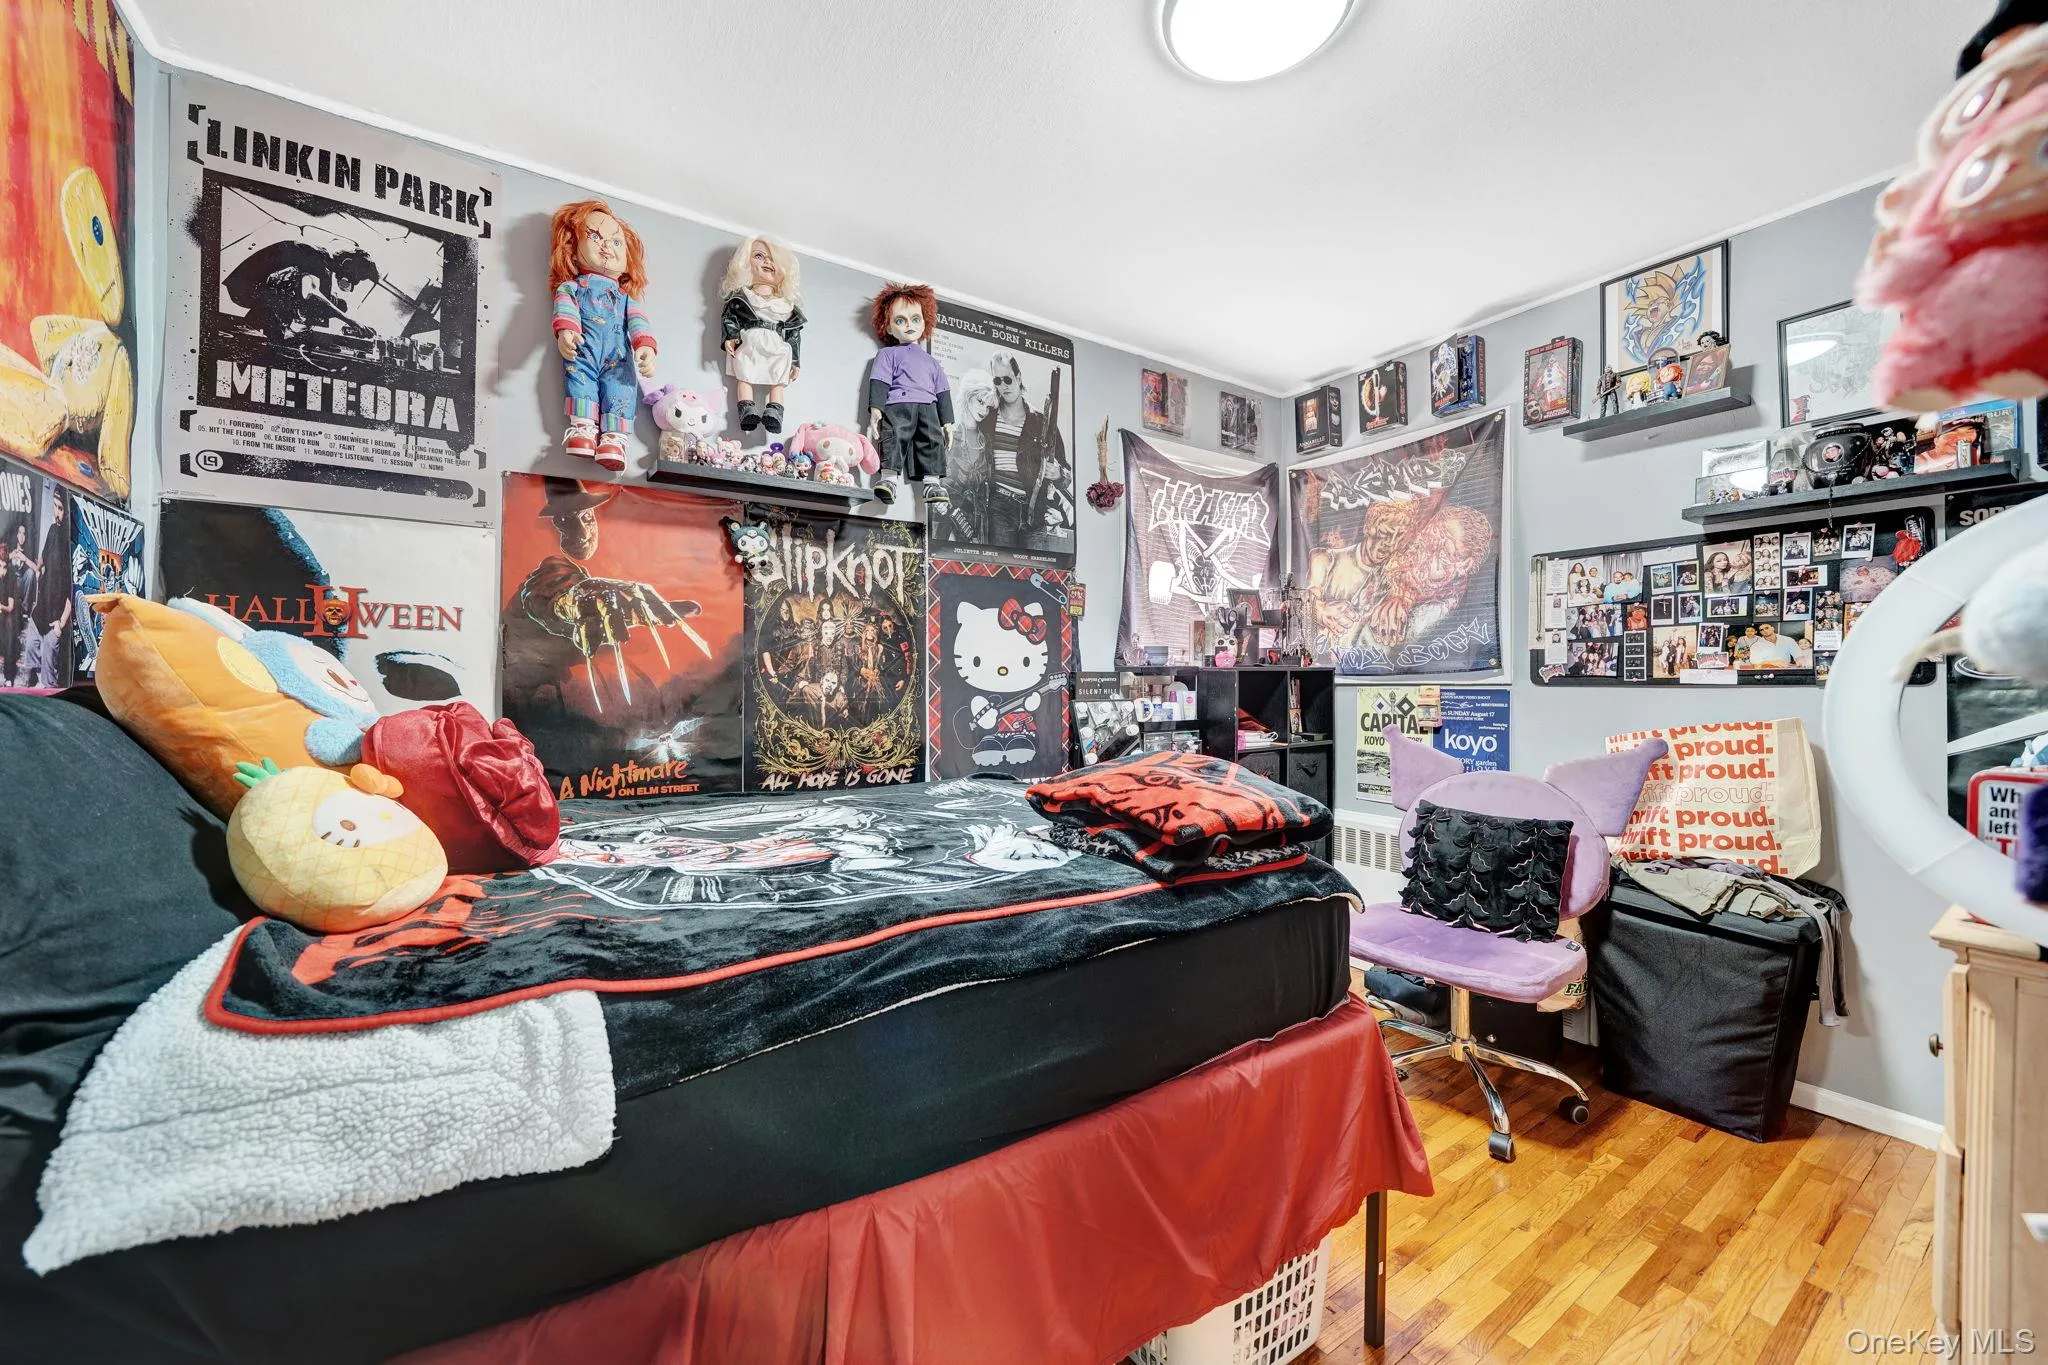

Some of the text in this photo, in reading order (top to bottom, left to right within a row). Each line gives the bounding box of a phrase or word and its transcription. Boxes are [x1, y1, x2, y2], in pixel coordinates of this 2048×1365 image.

[206, 118, 480, 228] LINKIN PARK
[936, 313, 1071, 360] NATURAL BORN KILLERS
[215, 359, 460, 433] METEORA
[209, 426, 220, 434] HIT
[222, 427, 234, 436] THE
[235, 429, 256, 439] FLOOR
[263, 433, 273, 441] 06.
[274, 434, 296, 444] EASIER
[298, 437, 306, 445] TO
[307, 438, 320, 447] RUN
[338, 443, 356, 452] FAINT
[416, 454, 443, 464] BREAKING
[444, 457, 455, 465] THE
[218, 418, 228, 426] 01.
[229, 419, 264, 431] FOREWORD
[281, 426, 300, 435] DON'T
[301, 429, 317, 437] STAY
[333, 434, 370, 445] SOMEWHERE
[374, 439, 396, 449] BELONG
[411, 445, 427, 453] LYING
[428, 447, 444, 455] FROM
[232, 438, 241, 446] 10.
[242, 439, 261, 448] FROM
[262, 441, 274, 450] THE
[275, 443, 297, 453] INSIDE
[313, 449, 344, 459] NOBODY'S
[344, 452, 375, 463] LISTENING
[389, 459, 414, 468] SESSION
[0, 471, 32, 514] ONES
[1140, 467, 1271, 546] THRASHER
[953, 547, 980, 555] JULIETTE
[1364, 735, 1386, 746] KOYO
[1444, 728, 1498, 756] koyo
[1674, 734, 1774, 761] proud.
[1459, 757, 1475, 765] ORY
[1679, 758, 1775, 783] proud.
[559, 759, 689, 801] A Nightmare
[618, 783, 700, 797] ON ELM STREET
[760, 767, 915, 792] ALL HOPE IS GONE
[1677, 782, 1775, 805] proud.
[1990, 786, 2022, 804] Wh
[1676, 806, 1775, 828] proud.
[1990, 820, 2018, 836] left
[1678, 830, 1782, 852] proud.
